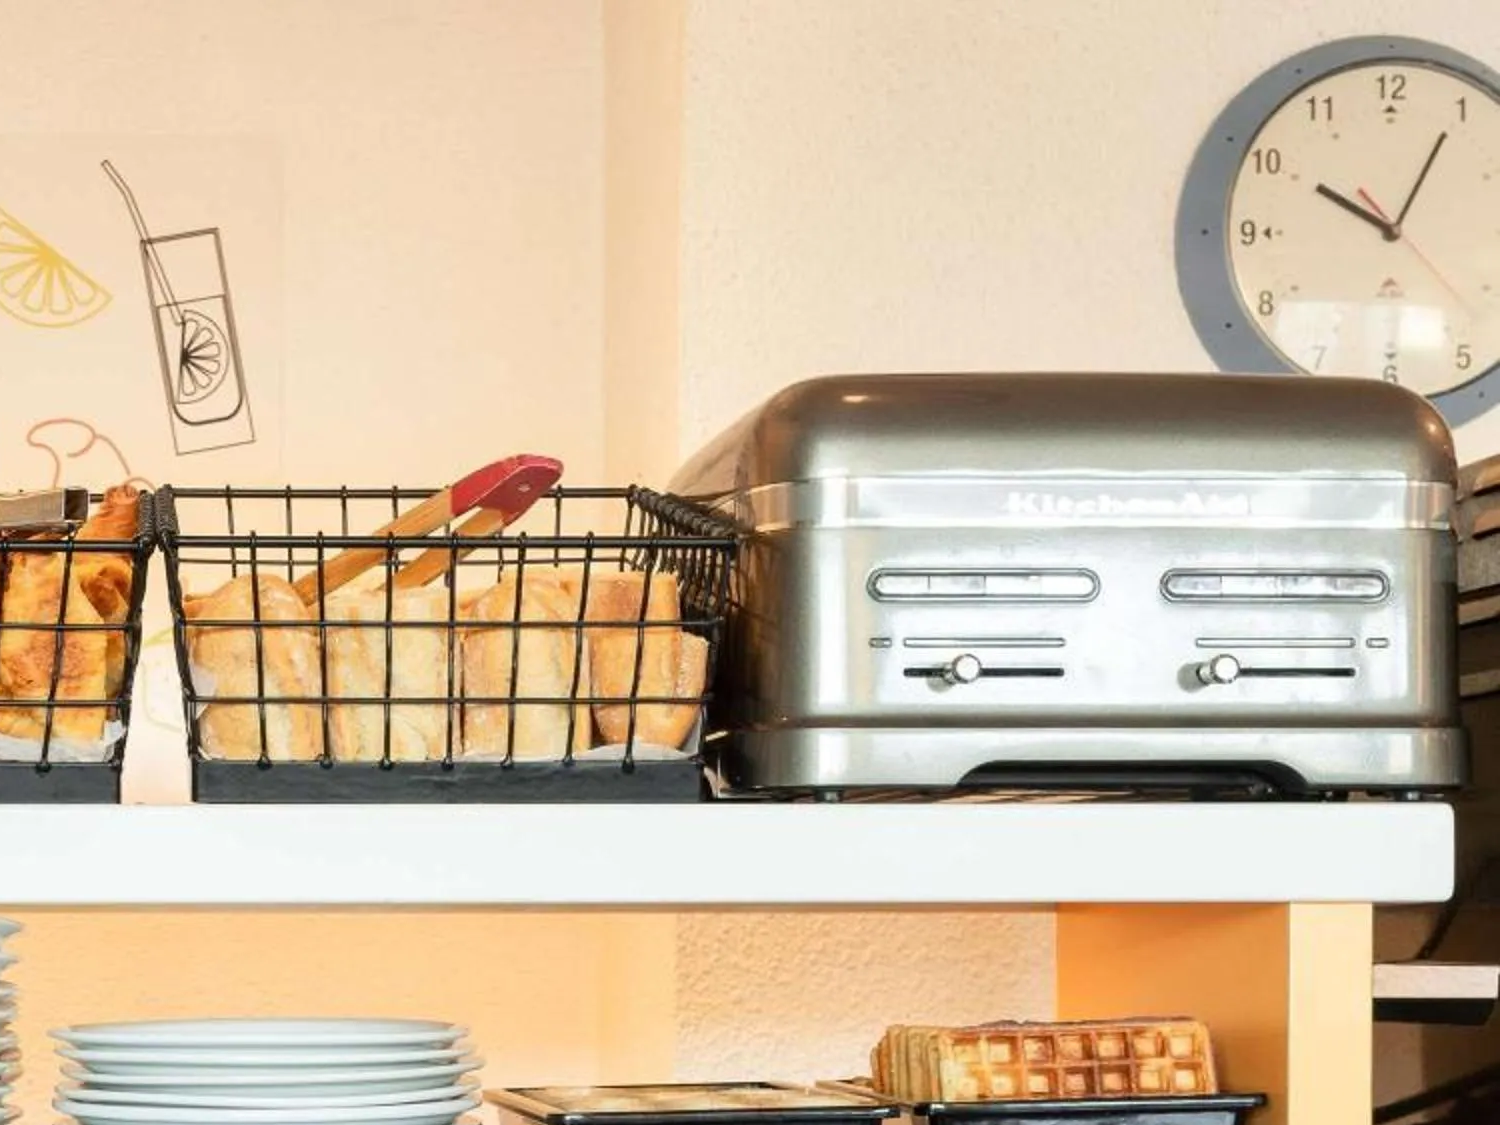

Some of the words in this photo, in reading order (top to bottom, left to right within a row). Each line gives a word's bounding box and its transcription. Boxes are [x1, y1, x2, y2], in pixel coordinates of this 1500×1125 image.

[1375, 73, 1407, 101] 12
[1305, 95, 1334, 122] 11
[1456, 96, 1467, 123] 1
[1251, 147, 1282, 175] 10
[1239, 219, 1257, 246] 9
[1257, 289, 1275, 317] 8
[1311, 345, 1328, 371] 7
[1455, 343, 1472, 370] 5
[1382, 364, 1398, 385] 6
